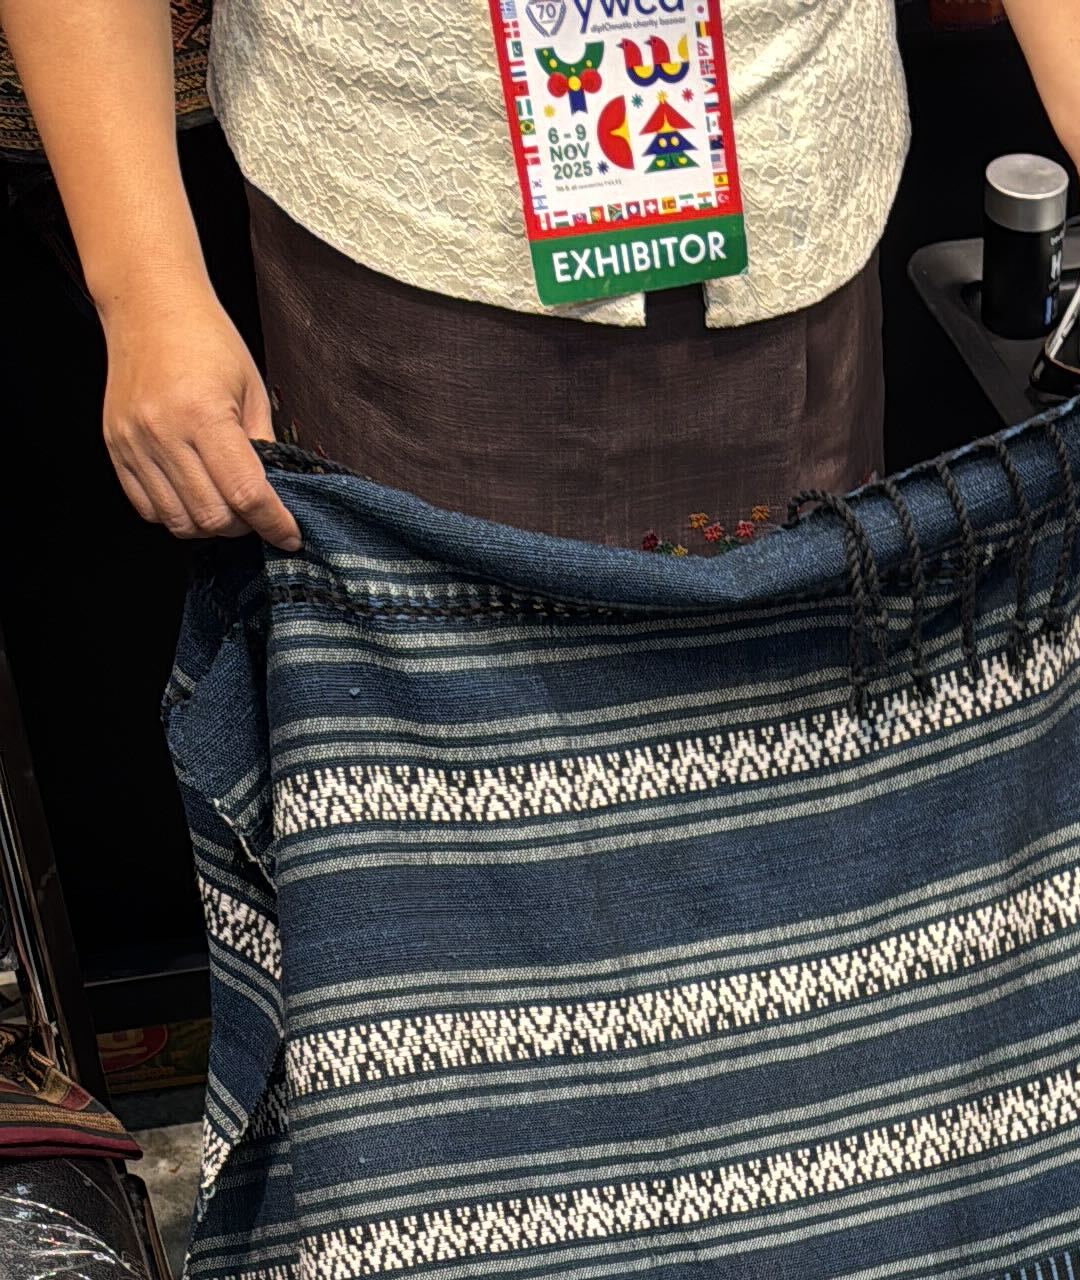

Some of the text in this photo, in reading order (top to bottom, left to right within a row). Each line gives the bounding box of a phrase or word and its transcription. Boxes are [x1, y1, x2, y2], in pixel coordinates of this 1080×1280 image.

[536, 4, 556, 19] 70
[548, 127, 559, 144] 6
[575, 124, 586, 141] 9
[549, 141, 590, 162] NOV
[552, 160, 593, 180] 2025
[552, 231, 727, 283] EXHIBITOR
